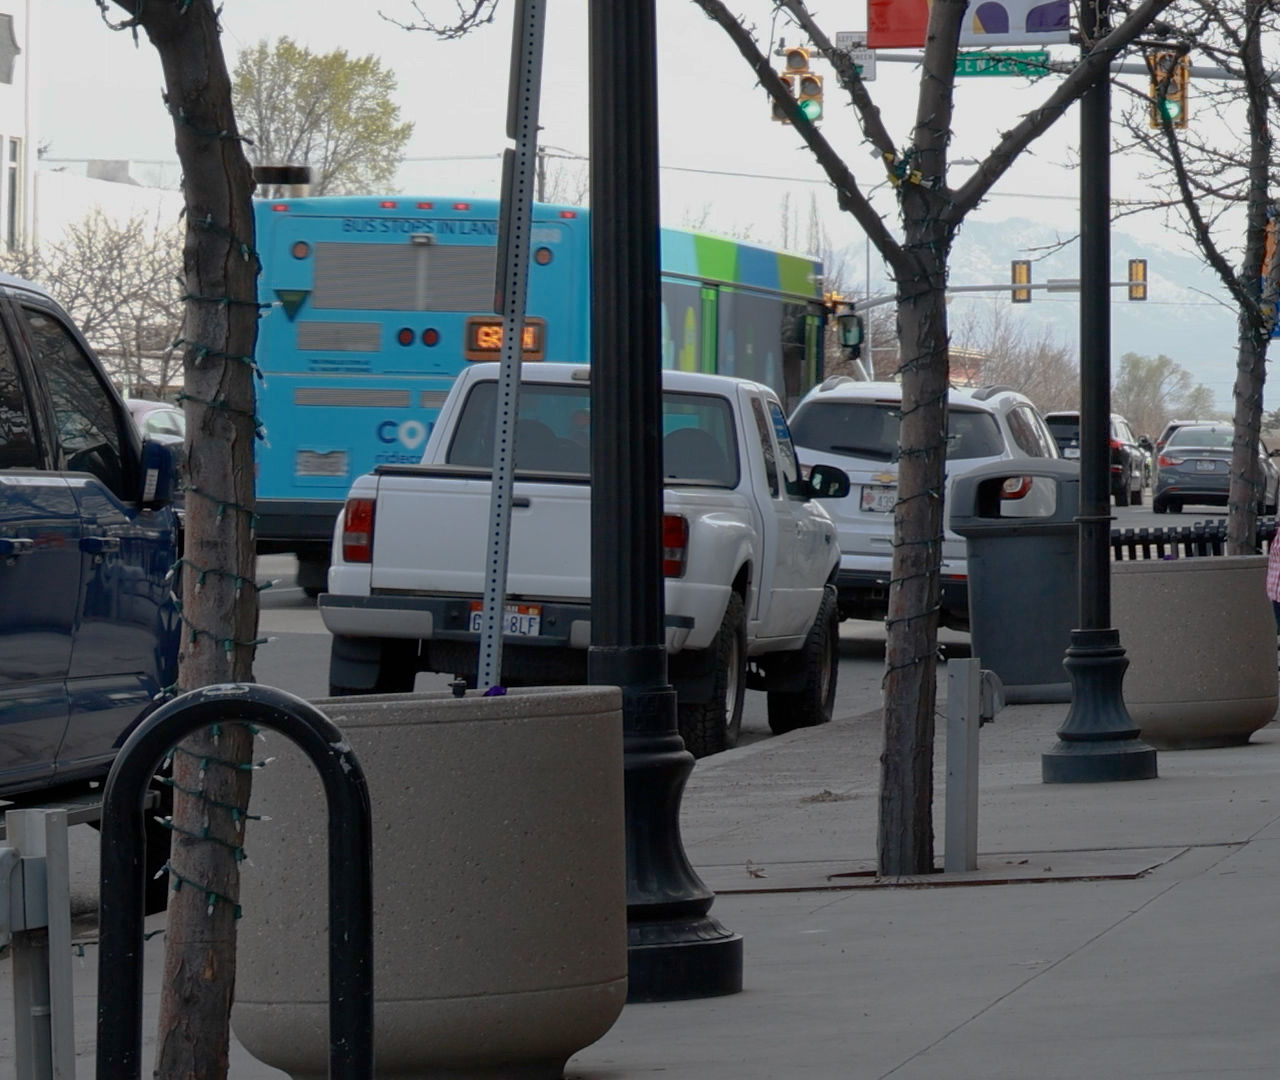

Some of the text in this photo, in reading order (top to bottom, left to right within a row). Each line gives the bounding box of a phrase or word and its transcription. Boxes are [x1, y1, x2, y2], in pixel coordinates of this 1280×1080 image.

[342, 219, 378, 232] BUS
[380, 220, 434, 234] STOPS
[437, 221, 454, 234] IN
